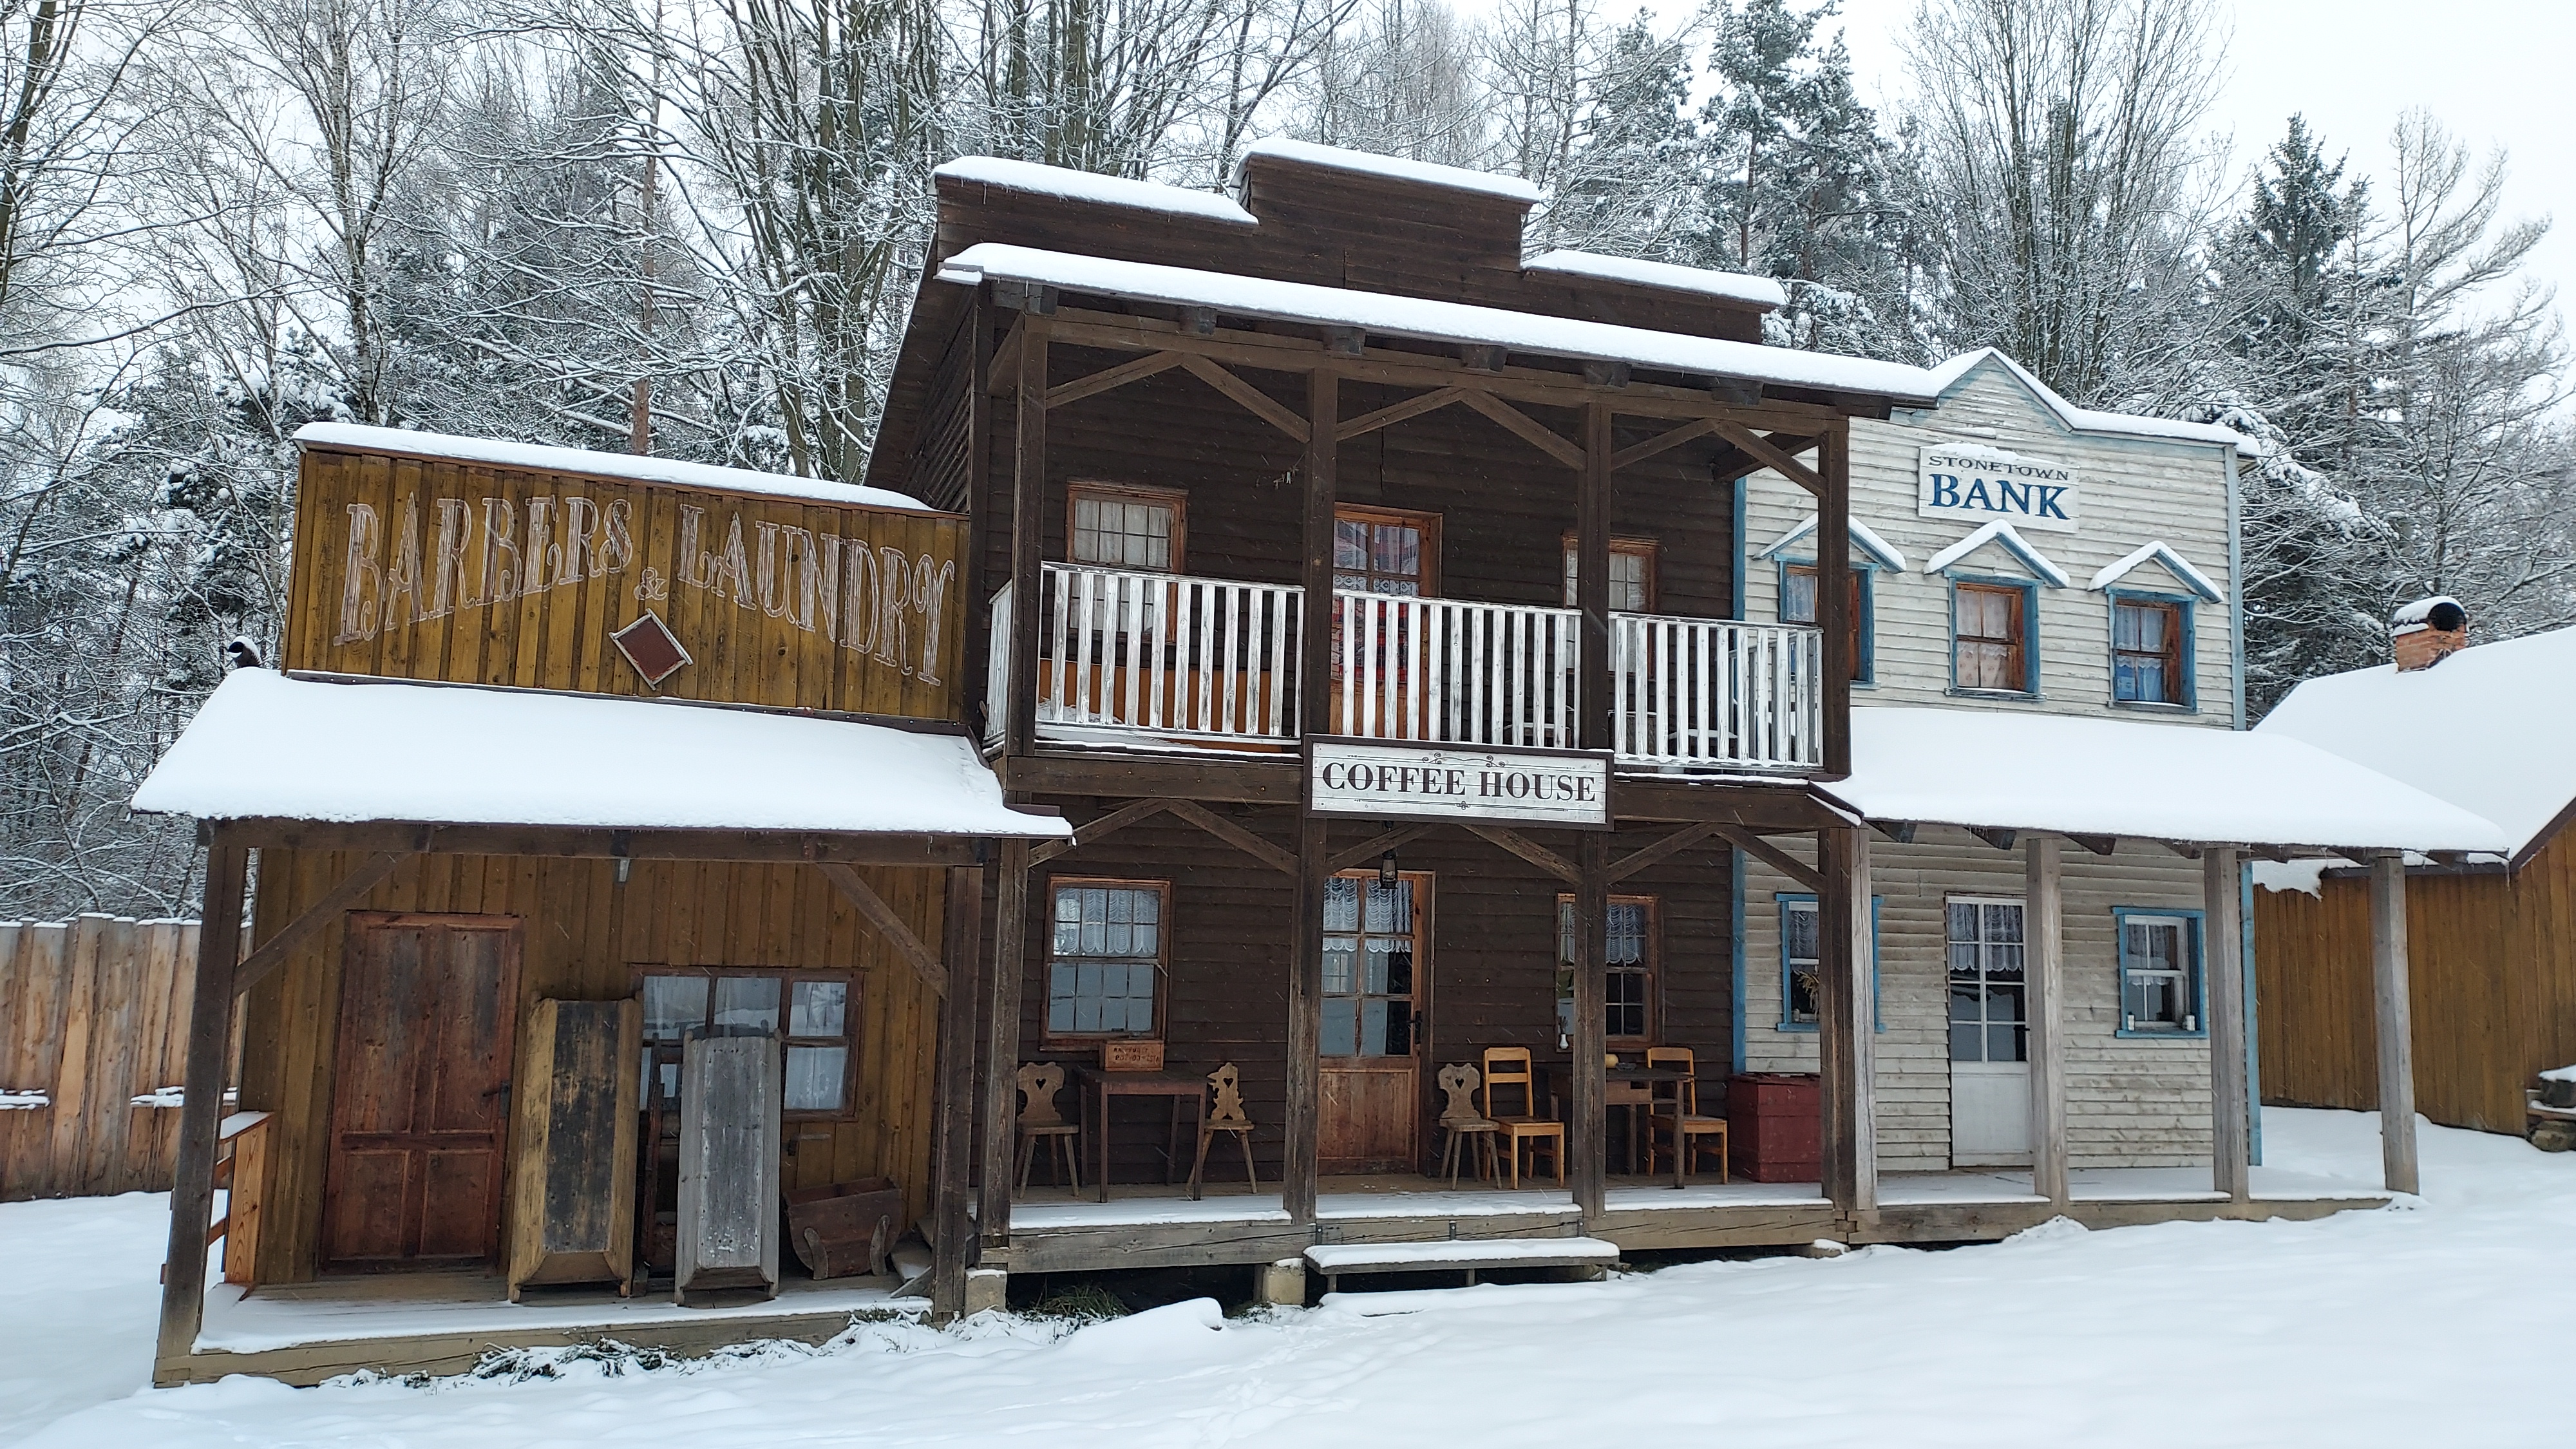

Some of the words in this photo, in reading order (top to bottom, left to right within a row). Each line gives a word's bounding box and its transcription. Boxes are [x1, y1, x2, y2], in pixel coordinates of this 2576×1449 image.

[1929, 455, 2069, 481] STONETOWN
[1928, 473, 2071, 520] BANK
[333, 491, 632, 646] BARBERS
[634, 567, 668, 600] &
[677, 502, 955, 687] LAUNDRY
[1322, 762, 1466, 796] COFFEE
[1478, 771, 1596, 802] HOUSE
